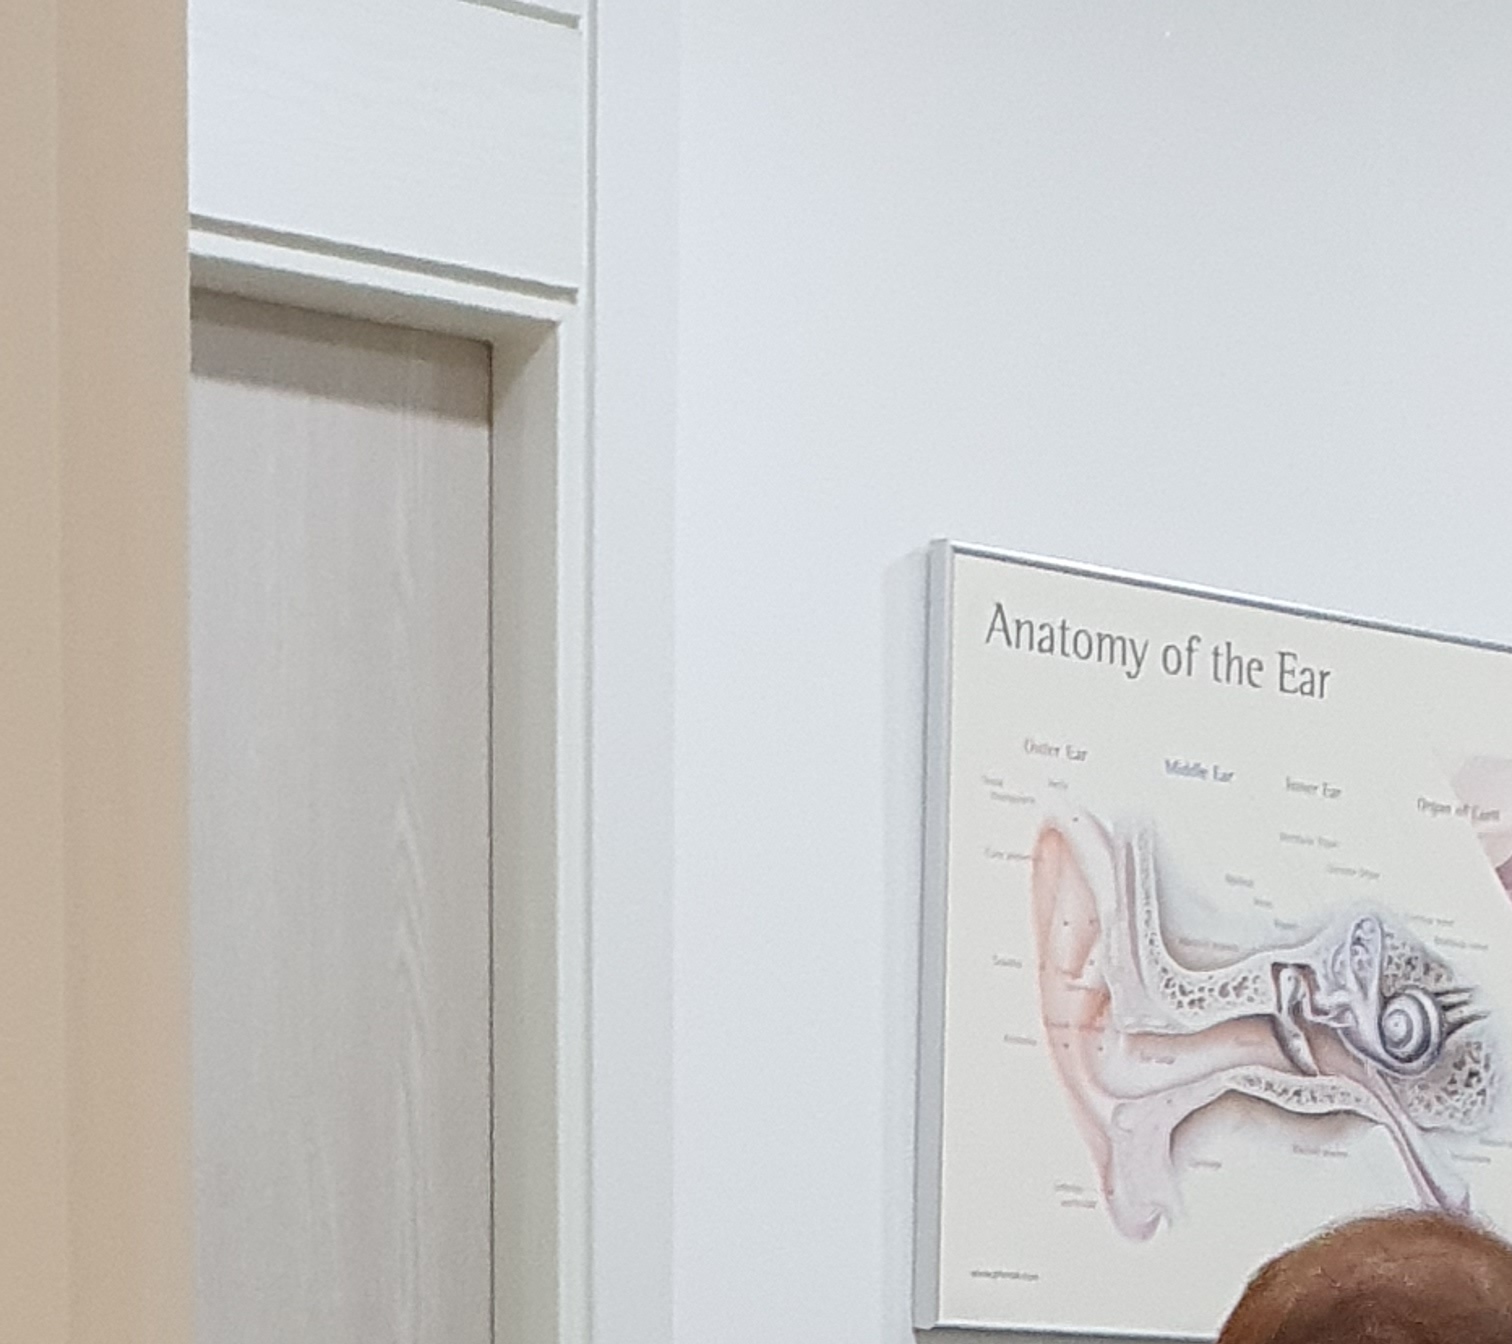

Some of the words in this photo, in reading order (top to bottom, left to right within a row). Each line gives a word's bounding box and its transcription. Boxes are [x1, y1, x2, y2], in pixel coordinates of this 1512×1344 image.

[985, 601, 1150, 680] Anatomy
[1161, 633, 1201, 678] of
[1210, 640, 1265, 689] the
[1275, 650, 1332, 700] Ear
[1023, 738, 1060, 758] Outer
[1065, 744, 1089, 762] Ear
[1164, 758, 1209, 780] Middle
[1212, 764, 1235, 783] Ear
[1285, 775, 1319, 796] Inner
[1321, 781, 1343, 799] Ear
